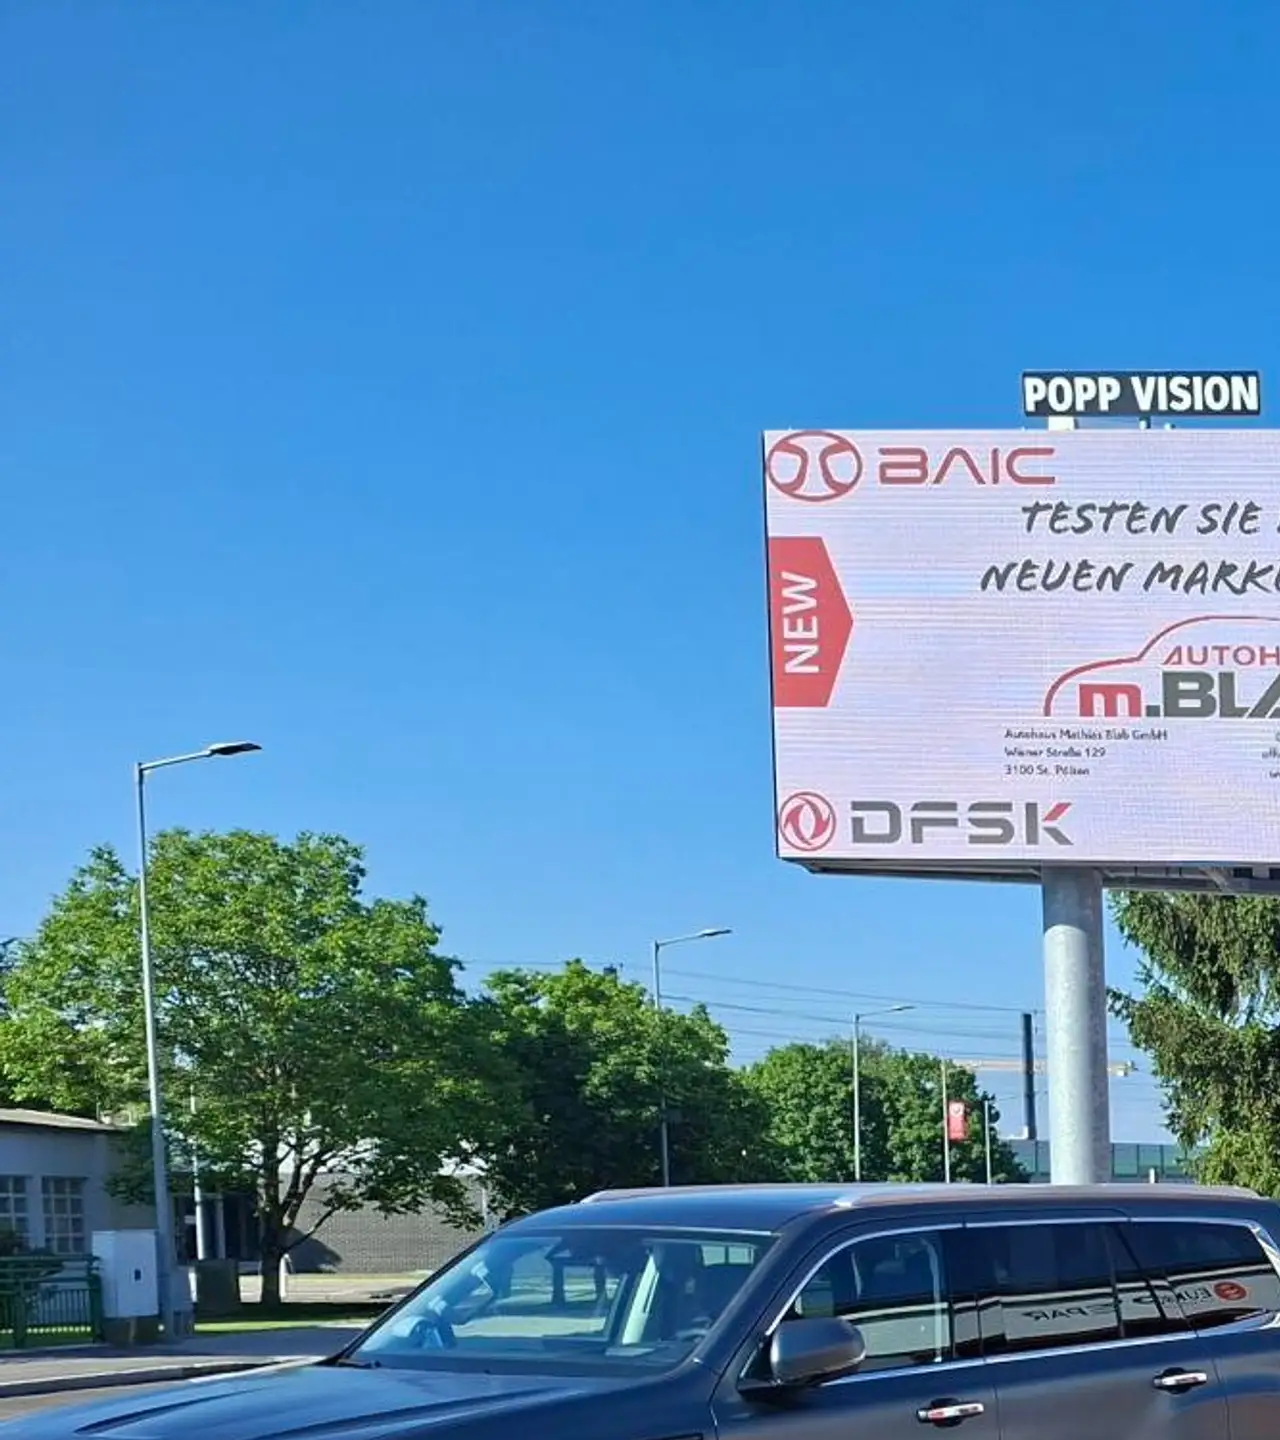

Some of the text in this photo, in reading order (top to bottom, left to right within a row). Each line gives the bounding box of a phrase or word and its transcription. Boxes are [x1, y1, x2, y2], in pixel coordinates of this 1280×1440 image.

[1024, 374, 1258, 412] POPP VISION
[879, 448, 1056, 486] BAIC
[1022, 502, 1187, 536] TESTEN
[1197, 502, 1262, 536] SIE
[980, 561, 1132, 592] NEUEN
[784, 571, 819, 675] NEW
[851, 801, 1073, 845] DFSK
